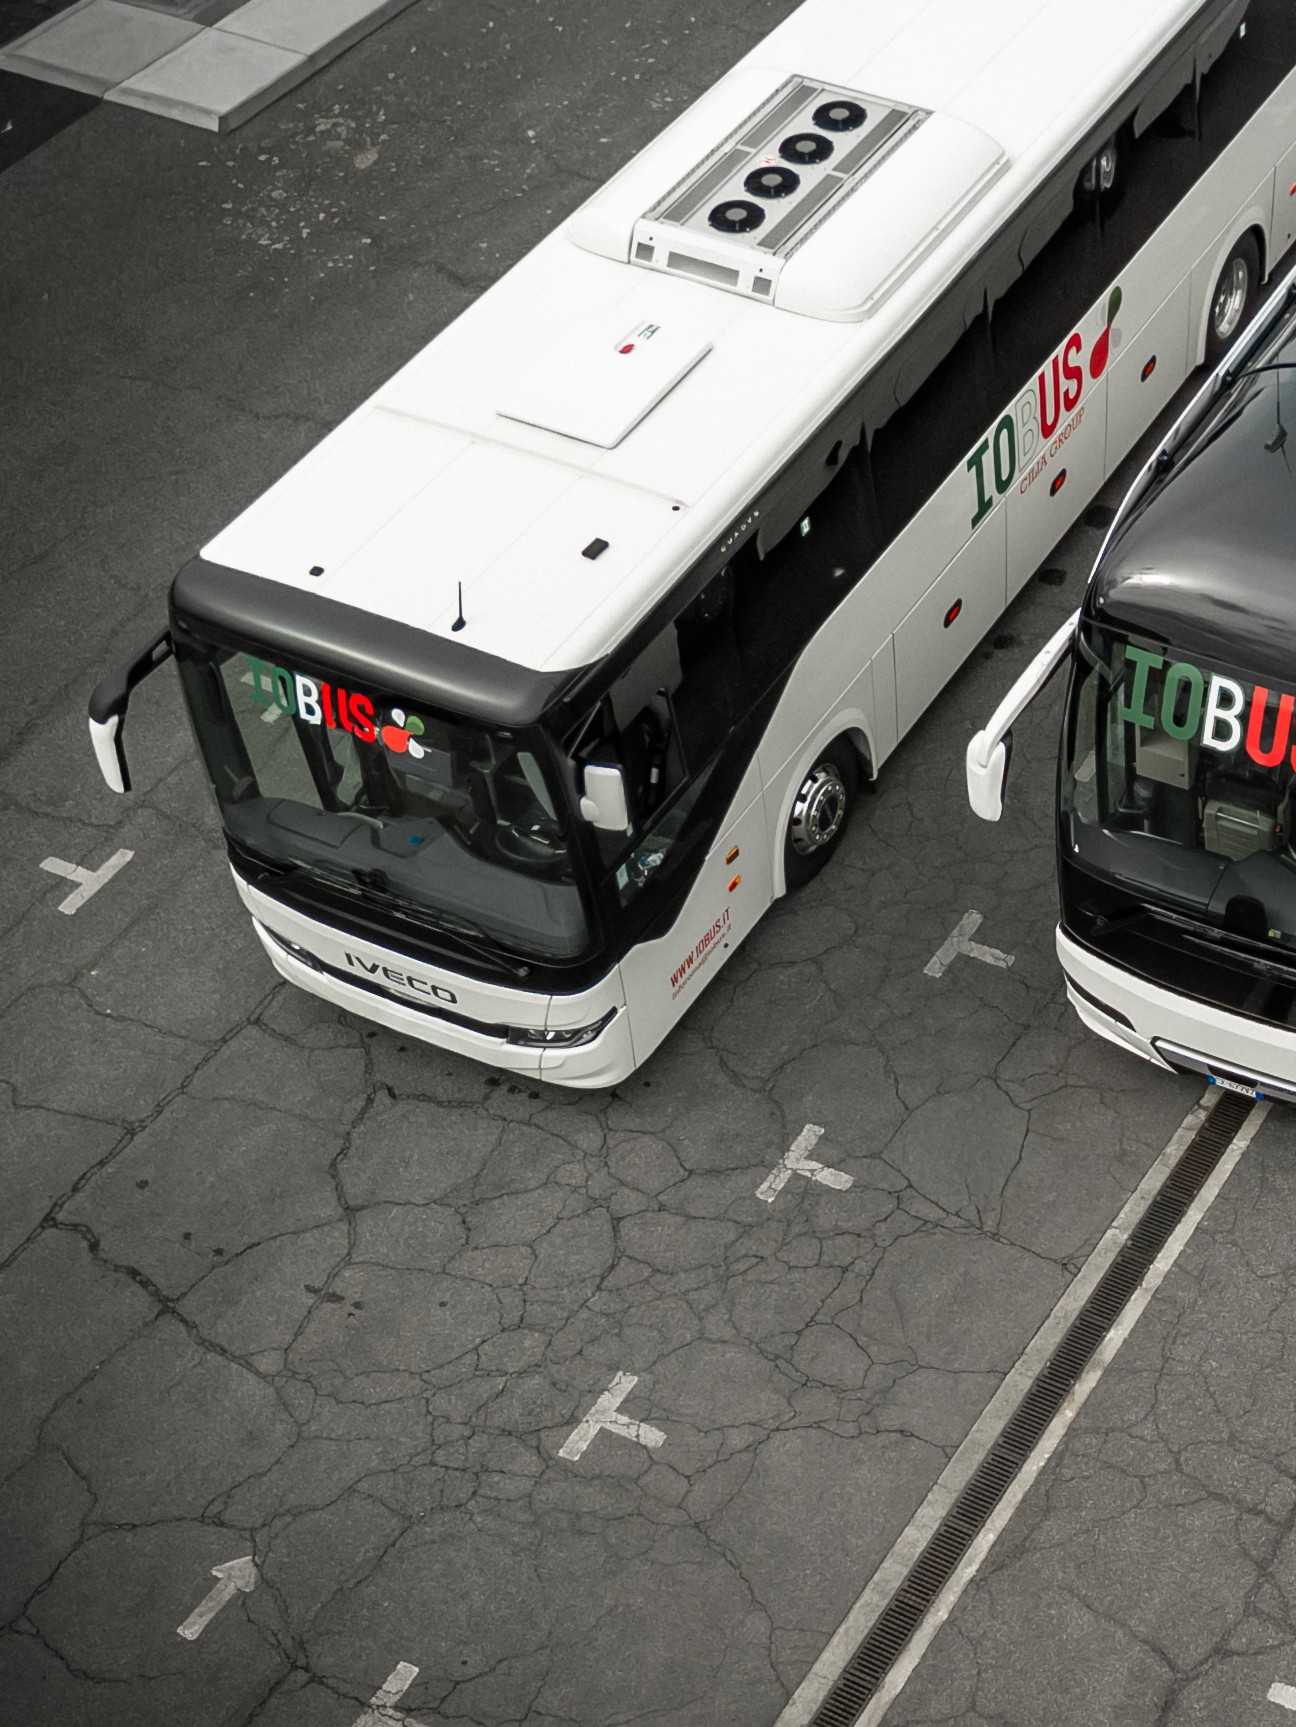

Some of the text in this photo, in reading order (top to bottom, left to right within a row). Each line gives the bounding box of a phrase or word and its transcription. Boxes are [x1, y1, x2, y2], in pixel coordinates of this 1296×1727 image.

[966, 332, 1083, 531] IOBUS
[1049, 406, 1085, 458] GROUP
[243, 653, 377, 744] IOBUS
[344, 950, 458, 1005] IVECO
[670, 906, 730, 989] WWW.IOBUS.IT
